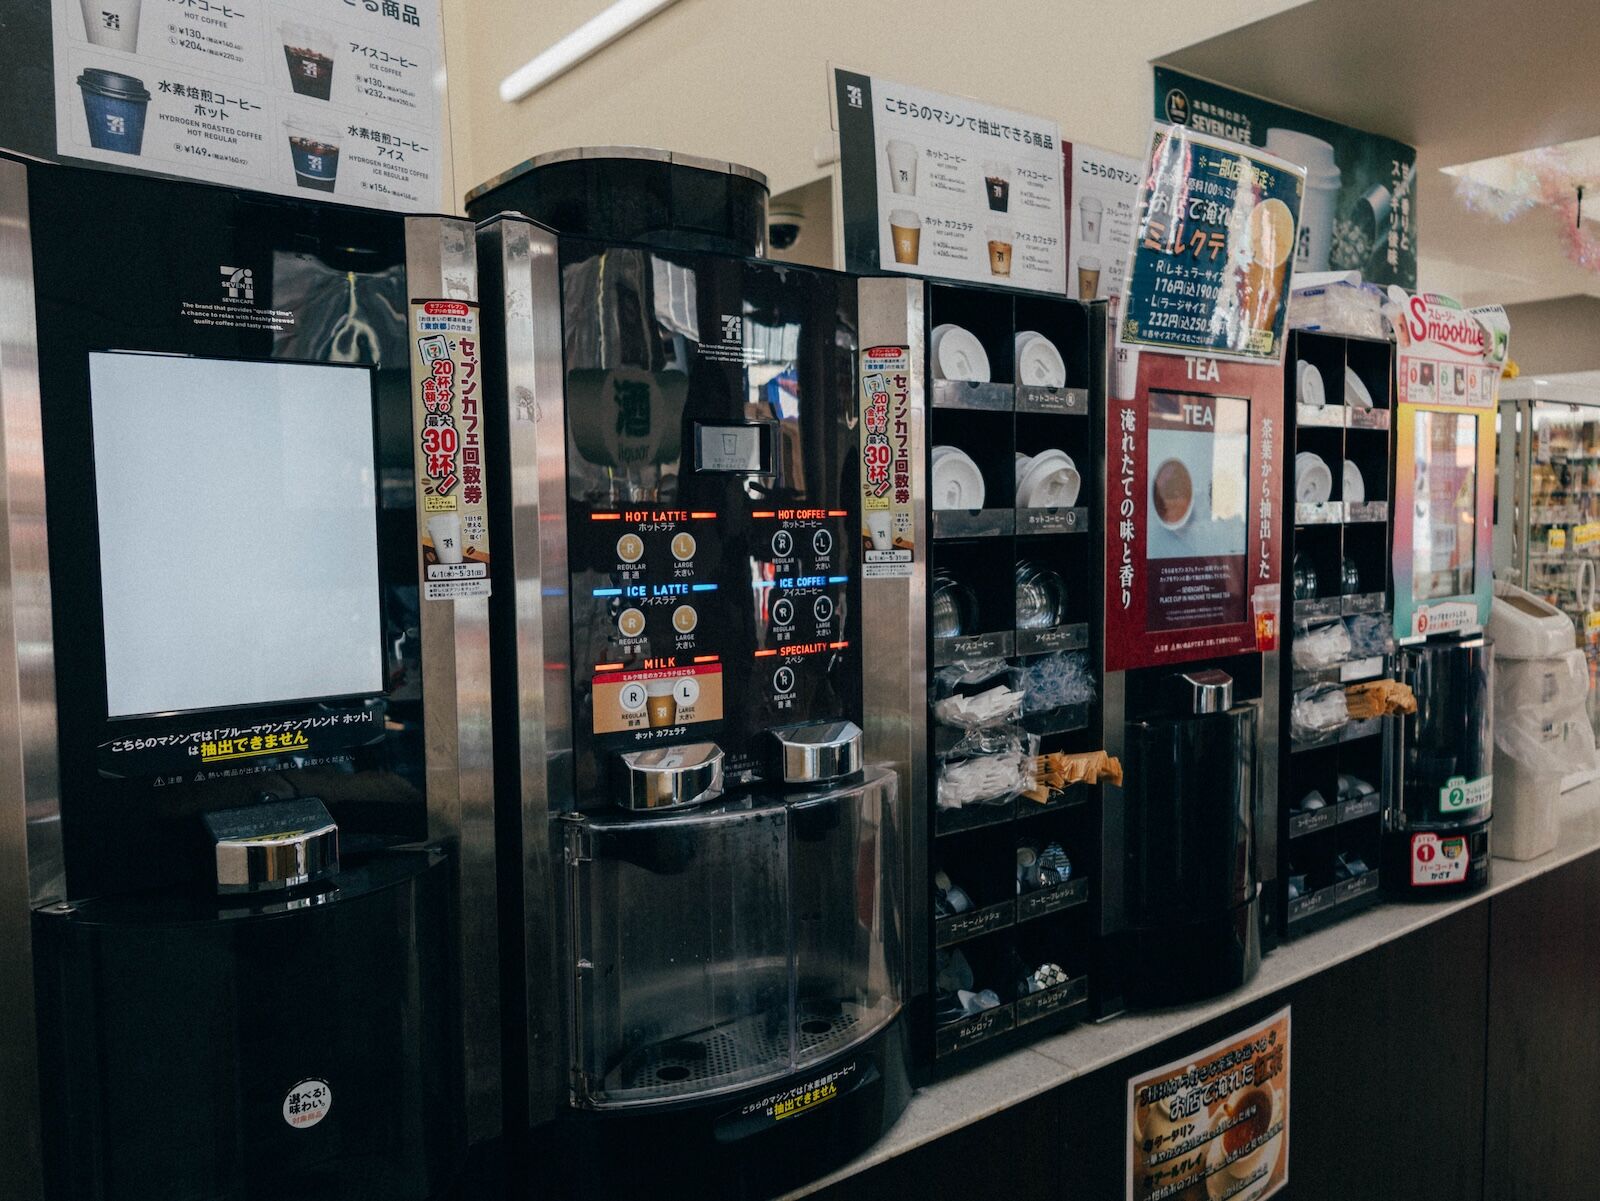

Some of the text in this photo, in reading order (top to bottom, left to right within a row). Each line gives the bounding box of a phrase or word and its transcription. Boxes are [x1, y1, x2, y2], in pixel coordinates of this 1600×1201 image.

[185, 12, 228, 29] HOT COFFEE
[350, 42, 418, 68] アイスコーヒー
[193, 103, 229, 120] ホット
[160, 113, 263, 141] HYDROGEN ROASTED COFFEE
[886, 97, 1053, 150] こちらのマシンで抽出できる商品
[188, 128, 238, 145] HOT REGULAR
[377, 146, 405, 162] アイス
[926, 149, 967, 163] ホットコーヒー
[1016, 168, 1053, 181] アイスコーヒー
[925, 217, 973, 232] ホット カフェラテ
[195, 303, 213, 311] brand
[227, 307, 253, 315] provides
[194, 318, 215, 327] quality
[247, 322, 261, 330] tasty
[262, 323, 284, 331] sweets.
[250, 315, 272, 323] freshly
[1410, 297, 1485, 346] Smoothie
[1185, 356, 1220, 383] TEA
[1028, 394, 1065, 403] ホットコーヒー
[428, 414, 451, 428] 最大
[458, 337, 483, 505] セブンカフェ回数券
[1182, 404, 1214, 427] TEA
[893, 374, 909, 504] セブンカフェ回数券
[1259, 418, 1273, 579] 茶葉から抽出した
[778, 510, 826, 520] HOT COFFEE
[1119, 408, 1135, 610] 淹れたての味と香り
[625, 511, 688, 522] HOT LATTE
[1029, 515, 1065, 524] ホットコーヒー
[638, 522, 676, 532] ホットラテ
[782, 520, 823, 529] ホットコーヒー
[674, 561, 694, 569] LARGE
[674, 569, 695, 577] 大きい
[779, 576, 826, 588] ICE COFFEE
[627, 584, 689, 597] ICE LATTE
[782, 588, 824, 598] アイスコーヒー
[640, 596, 678, 606] アイスラテ
[619, 637, 647, 646] REGULAR
[1035, 632, 1071, 643] アイスコーヒー
[675, 641, 695, 650] 大きい
[780, 642, 827, 656] SPECIALITY
[954, 641, 995, 652] アイスコーヒー
[644, 656, 676, 670] MILK
[622, 712, 646, 720] REGULAR
[679, 713, 695, 721] 大きい
[634, 726, 687, 743] ホット カフェラテ
